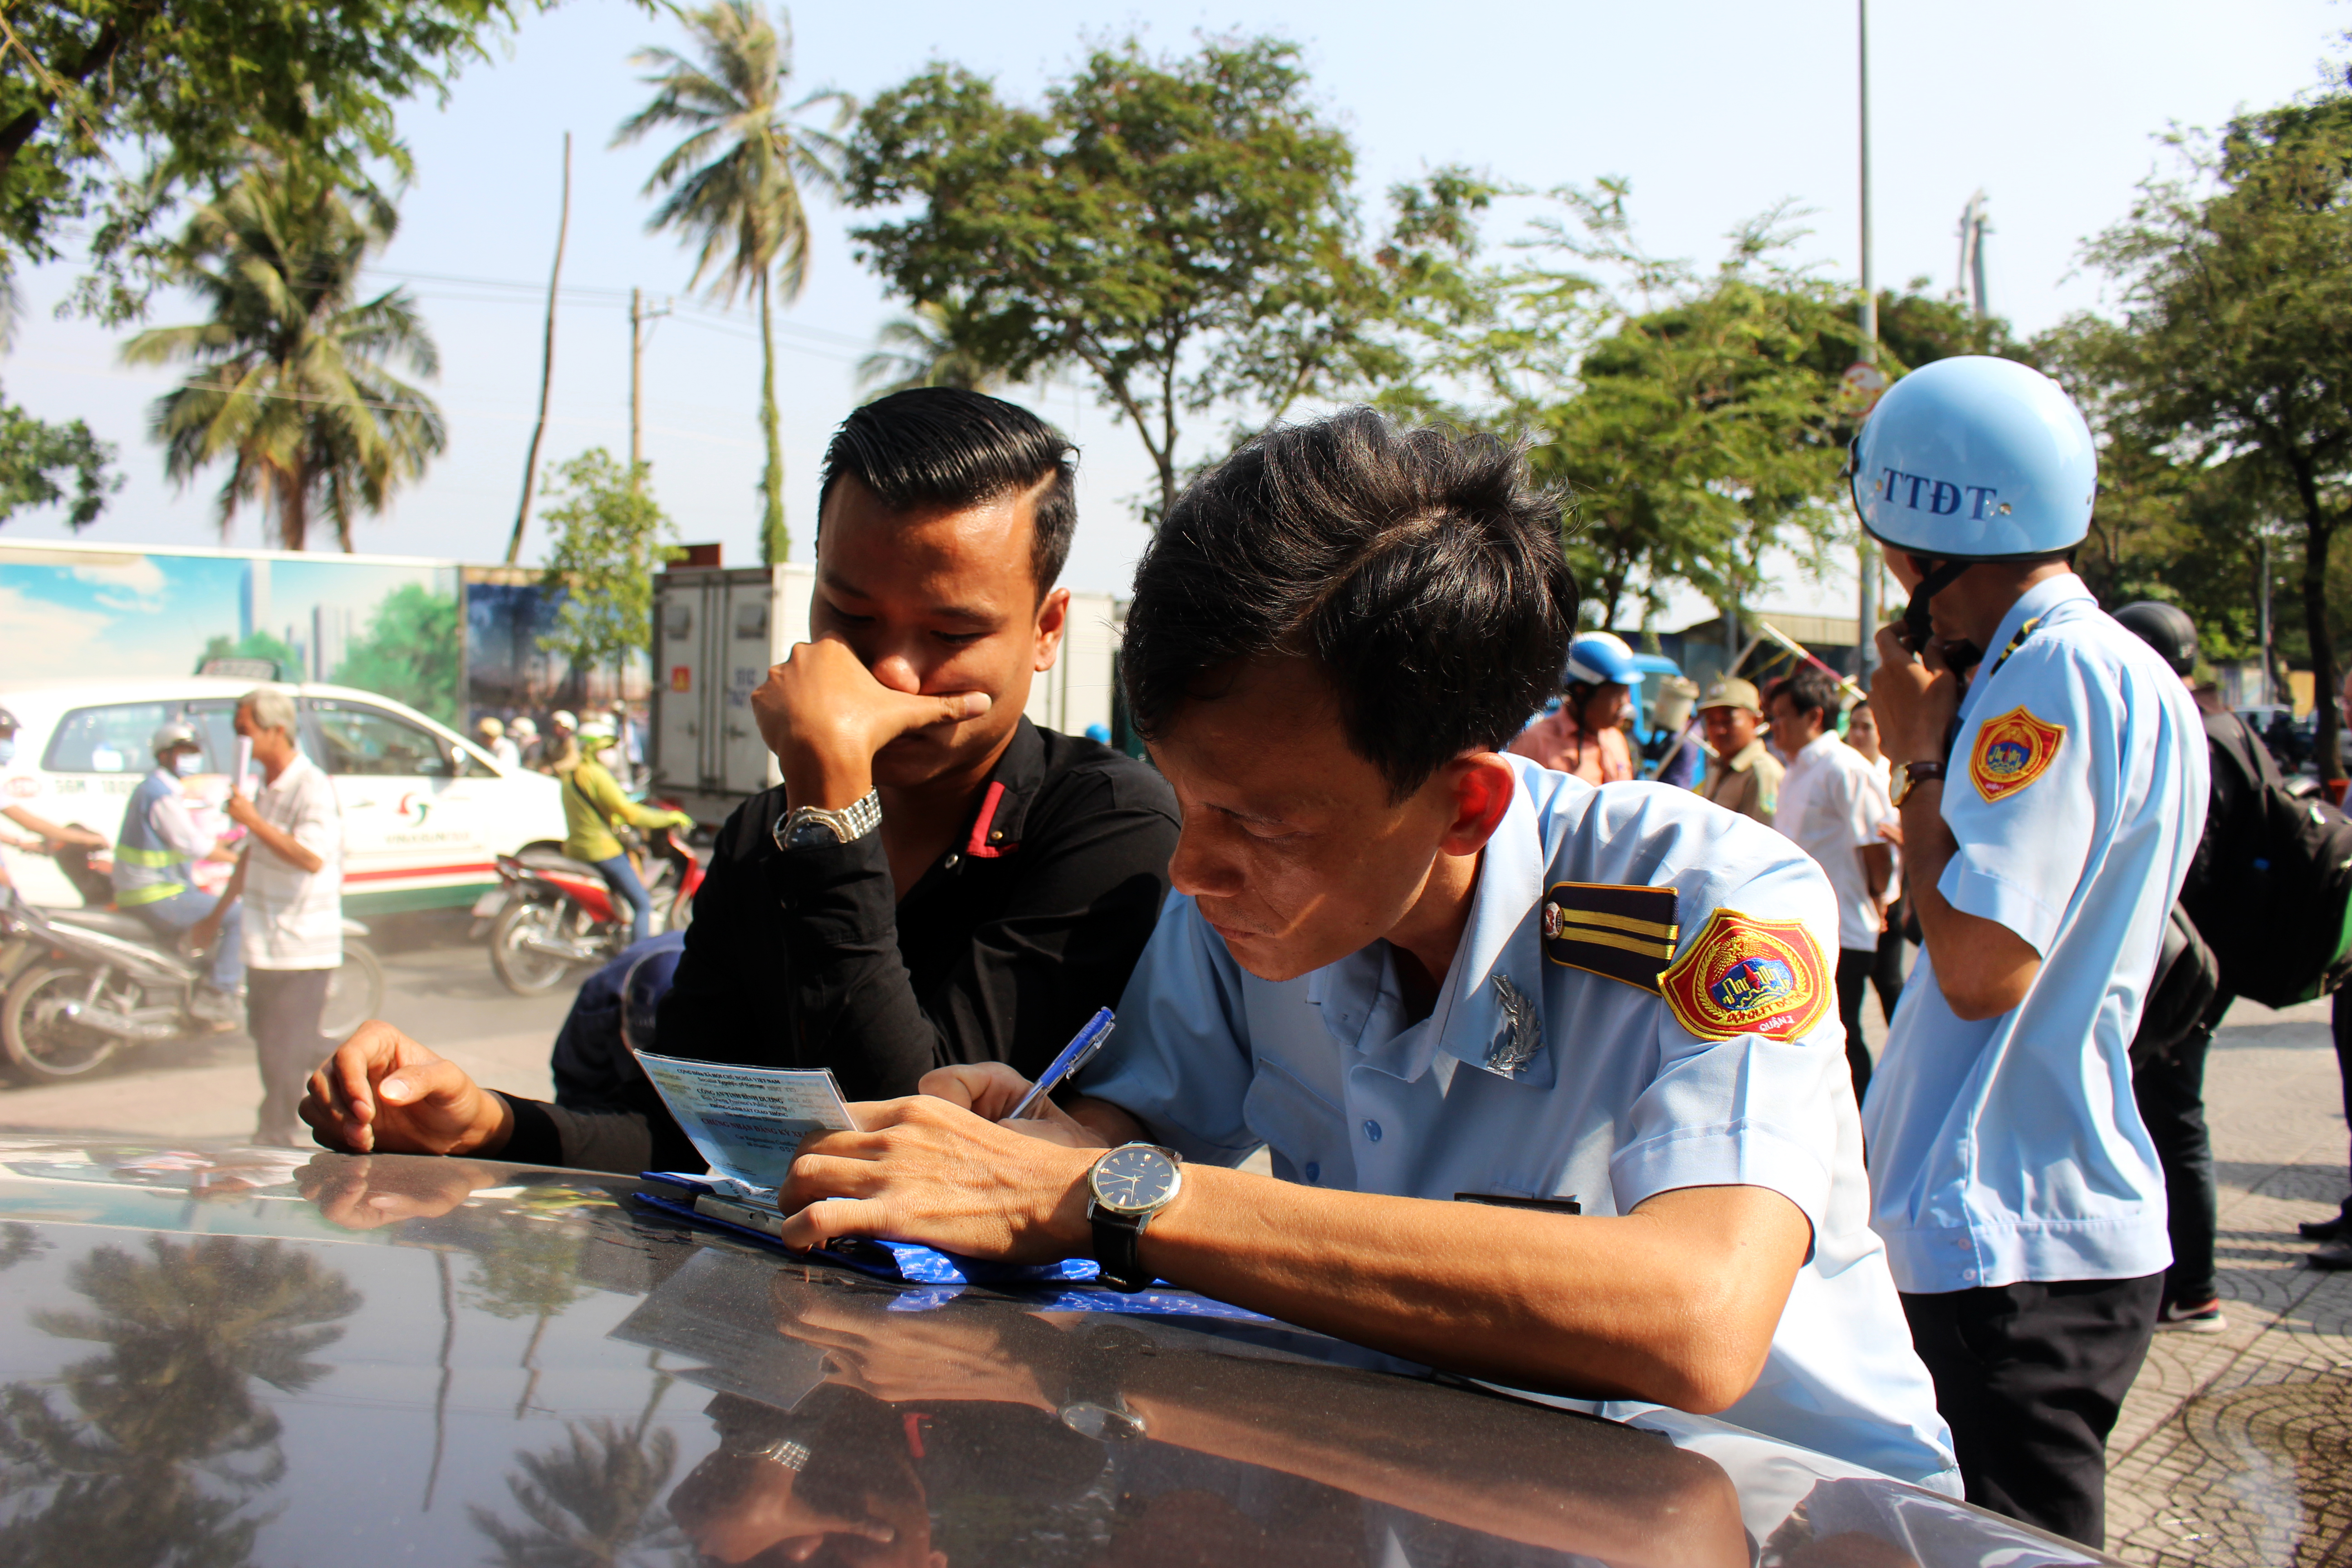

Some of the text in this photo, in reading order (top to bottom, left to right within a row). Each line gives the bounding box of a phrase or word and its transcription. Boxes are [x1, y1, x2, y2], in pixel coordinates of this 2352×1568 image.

[1883, 467, 1997, 521] TTĐT
[1759, 1016, 1787, 1032] QUẬN
[701, 1118, 730, 1127] CHỨNG
